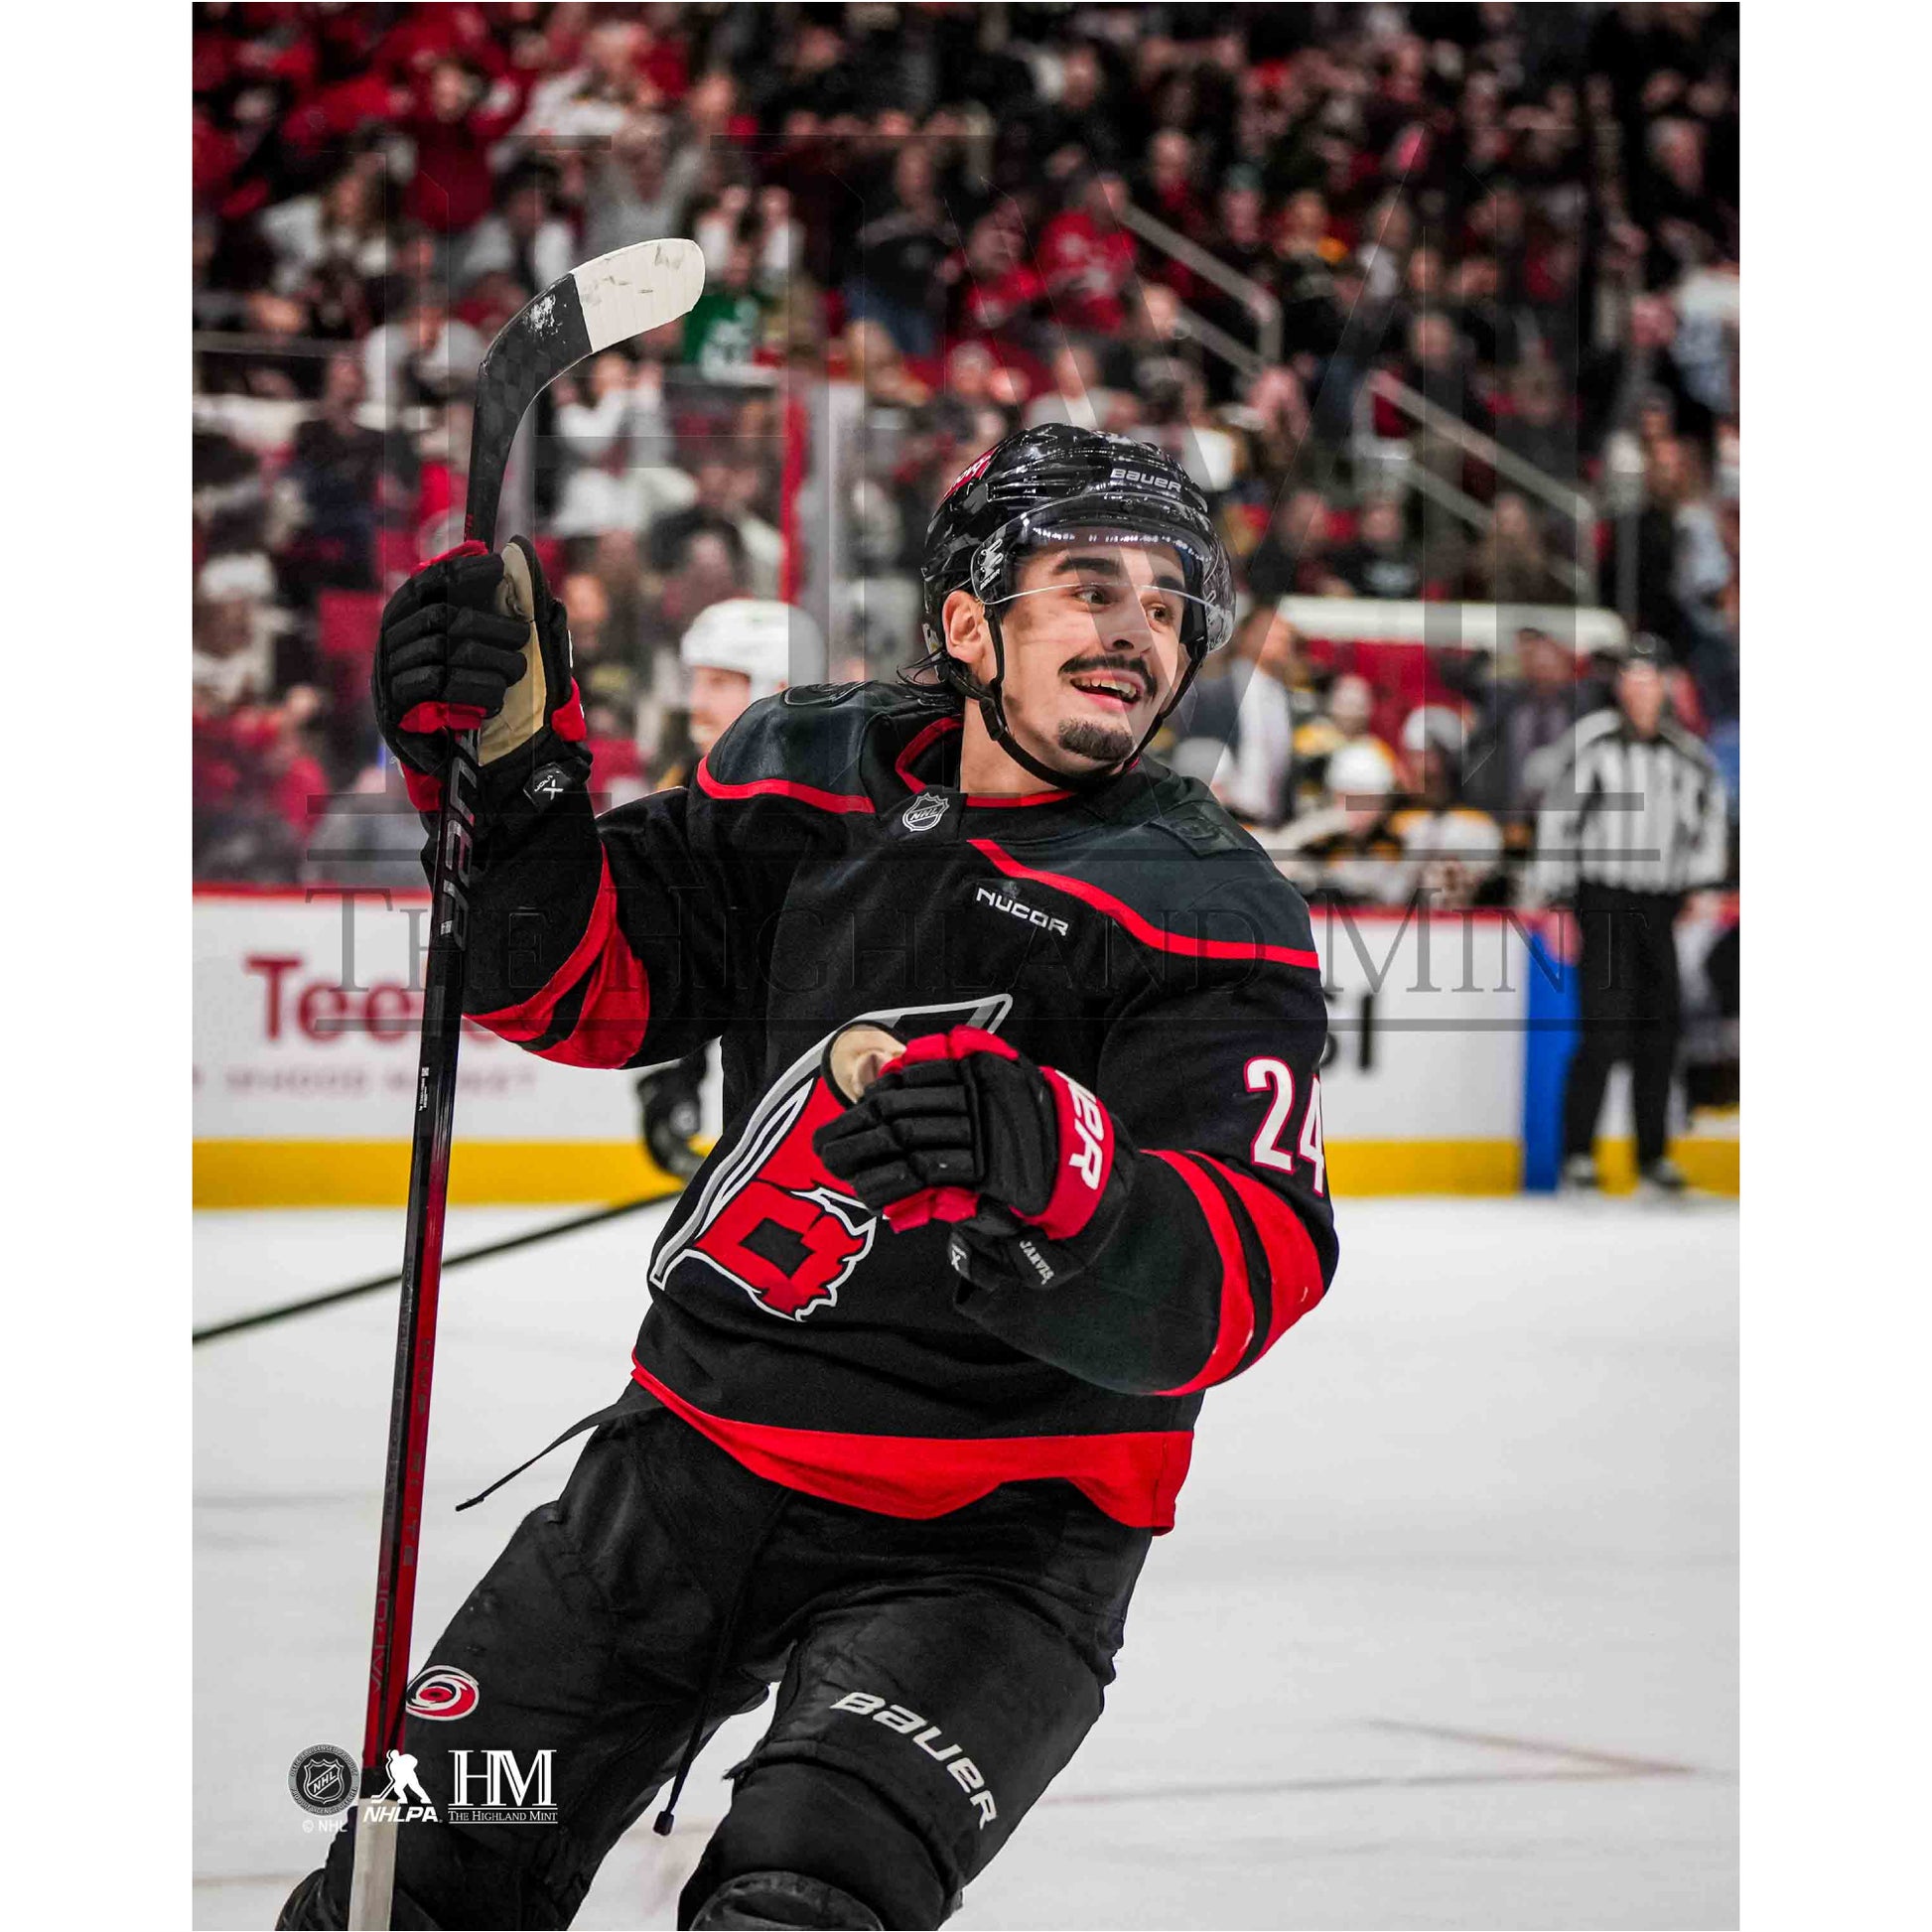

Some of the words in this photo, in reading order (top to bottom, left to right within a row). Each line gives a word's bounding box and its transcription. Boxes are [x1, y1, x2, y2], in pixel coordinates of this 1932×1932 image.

[1109, 467, 1182, 493] BAUER
[440, 730, 482, 951] UER
[975, 887, 1069, 937] NUCOR
[1244, 1054, 1325, 1198] 24
[829, 1691, 999, 1832] BAUER
